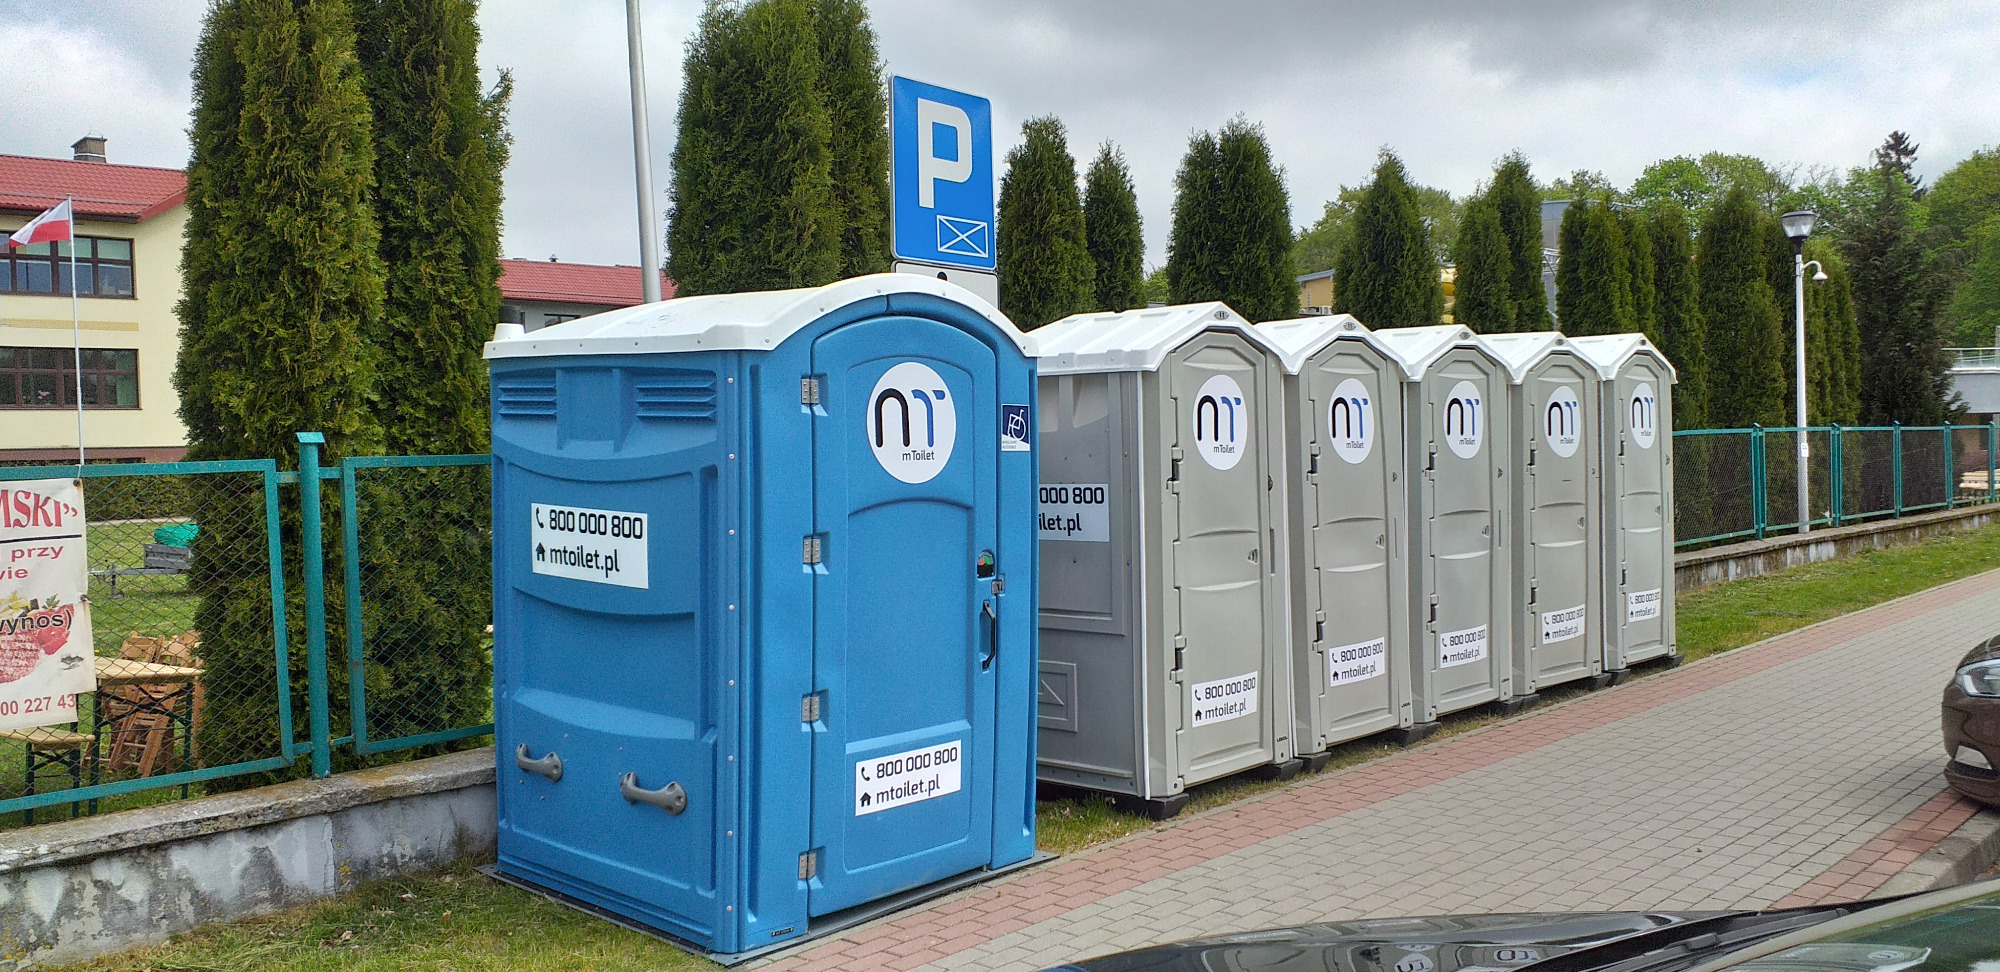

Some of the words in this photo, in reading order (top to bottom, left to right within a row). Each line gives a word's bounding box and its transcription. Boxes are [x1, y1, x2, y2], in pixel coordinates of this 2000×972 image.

[917, 97, 973, 209] P
[902, 449, 935, 462] mToilet
[1213, 444, 1235, 454] mToilet
[1072, 487, 1104, 504] 800
[549, 509, 575, 533] 800
[579, 512, 607, 536] 000
[611, 515, 643, 539] 800
[11, 546, 64, 563] przy
[549, 544, 620, 578] mtoilet.pl
[1340, 649, 1357, 662] 800
[1358, 646, 1371, 658] 000
[1341, 660, 1376, 680] mtoilet.pl
[1205, 684, 1223, 700] 800
[1225, 681, 1241, 696] 000
[1242, 676, 1256, 691] 800
[24, 696, 52, 713] 227
[1205, 697, 1246, 720] mtoilet.pl
[876, 759, 903, 779] 800
[906, 752, 931, 772] 000
[934, 746, 958, 766] 800
[876, 773, 941, 804] mtoilet.pl
